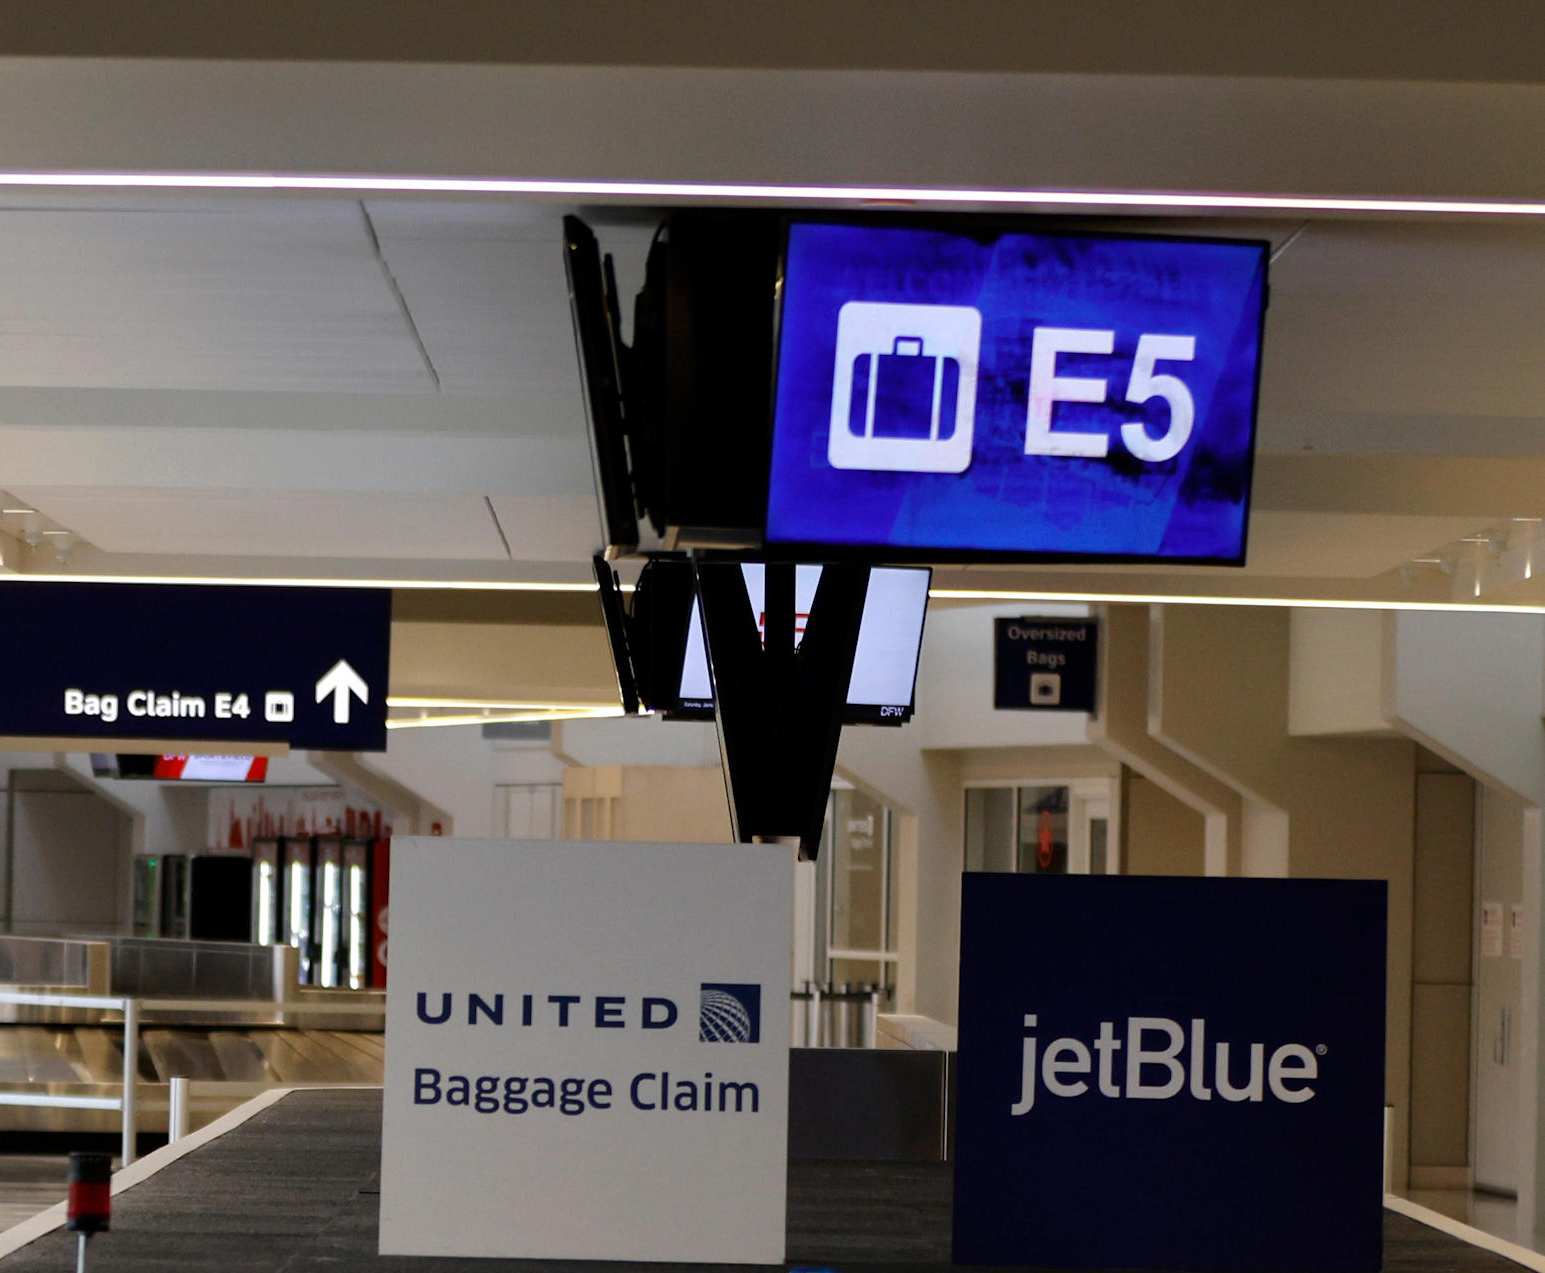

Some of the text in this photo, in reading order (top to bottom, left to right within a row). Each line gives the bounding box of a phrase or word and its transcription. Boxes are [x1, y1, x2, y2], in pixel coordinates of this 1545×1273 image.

[1024, 326, 1196, 462] E5
[1008, 625, 1087, 641] Oversized
[1026, 650, 1066, 669] Bags
[64, 688, 251, 722] Bag Claim E4
[880, 705, 904, 717] DFW
[416, 992, 678, 1029] UNITED
[414, 1067, 760, 1116] Baggage Claim
